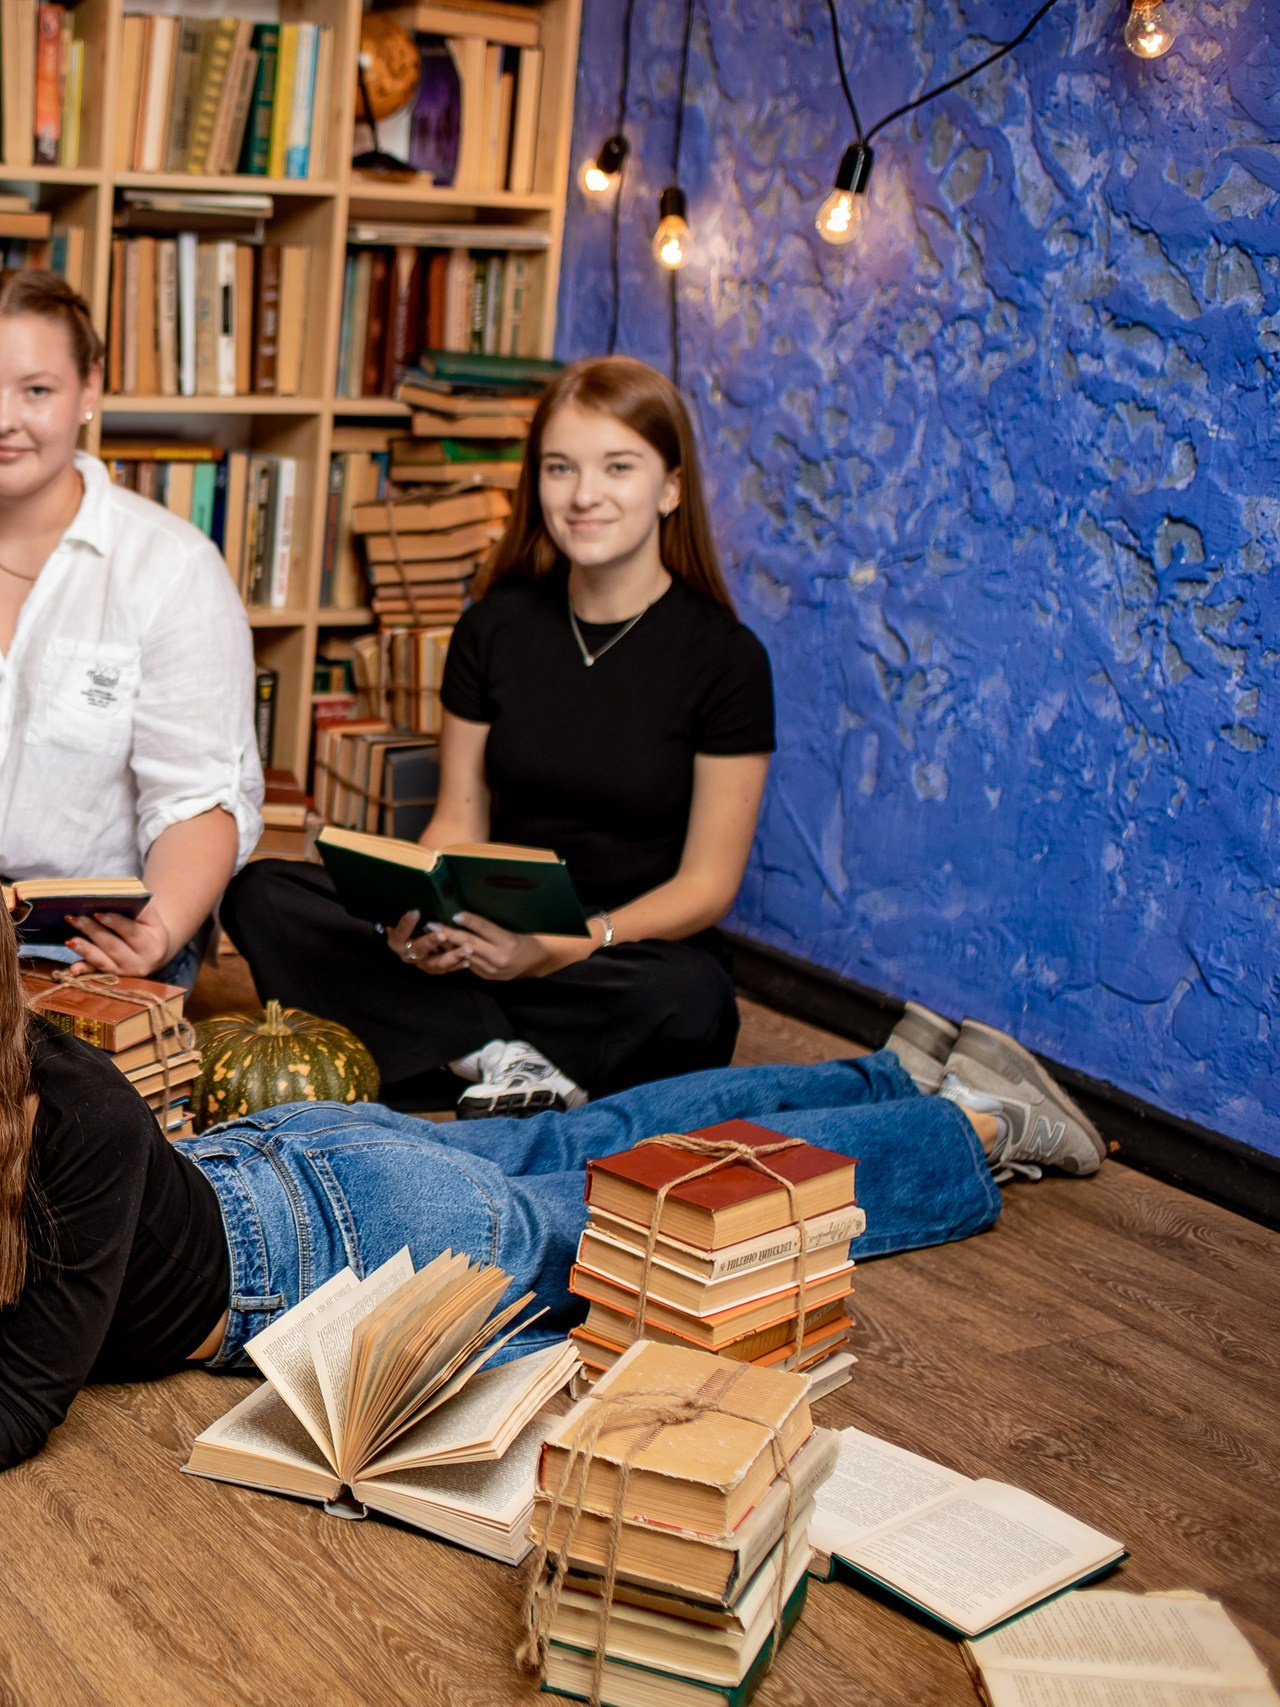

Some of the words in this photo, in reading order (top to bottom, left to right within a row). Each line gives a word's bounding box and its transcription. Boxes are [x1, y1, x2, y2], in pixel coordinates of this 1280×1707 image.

[1025, 1115, 1066, 1157] N
[726, 1250, 758, 1270] ОНЕГИН
[758, 1239, 793, 1262] ЕВГЕНИЙ
